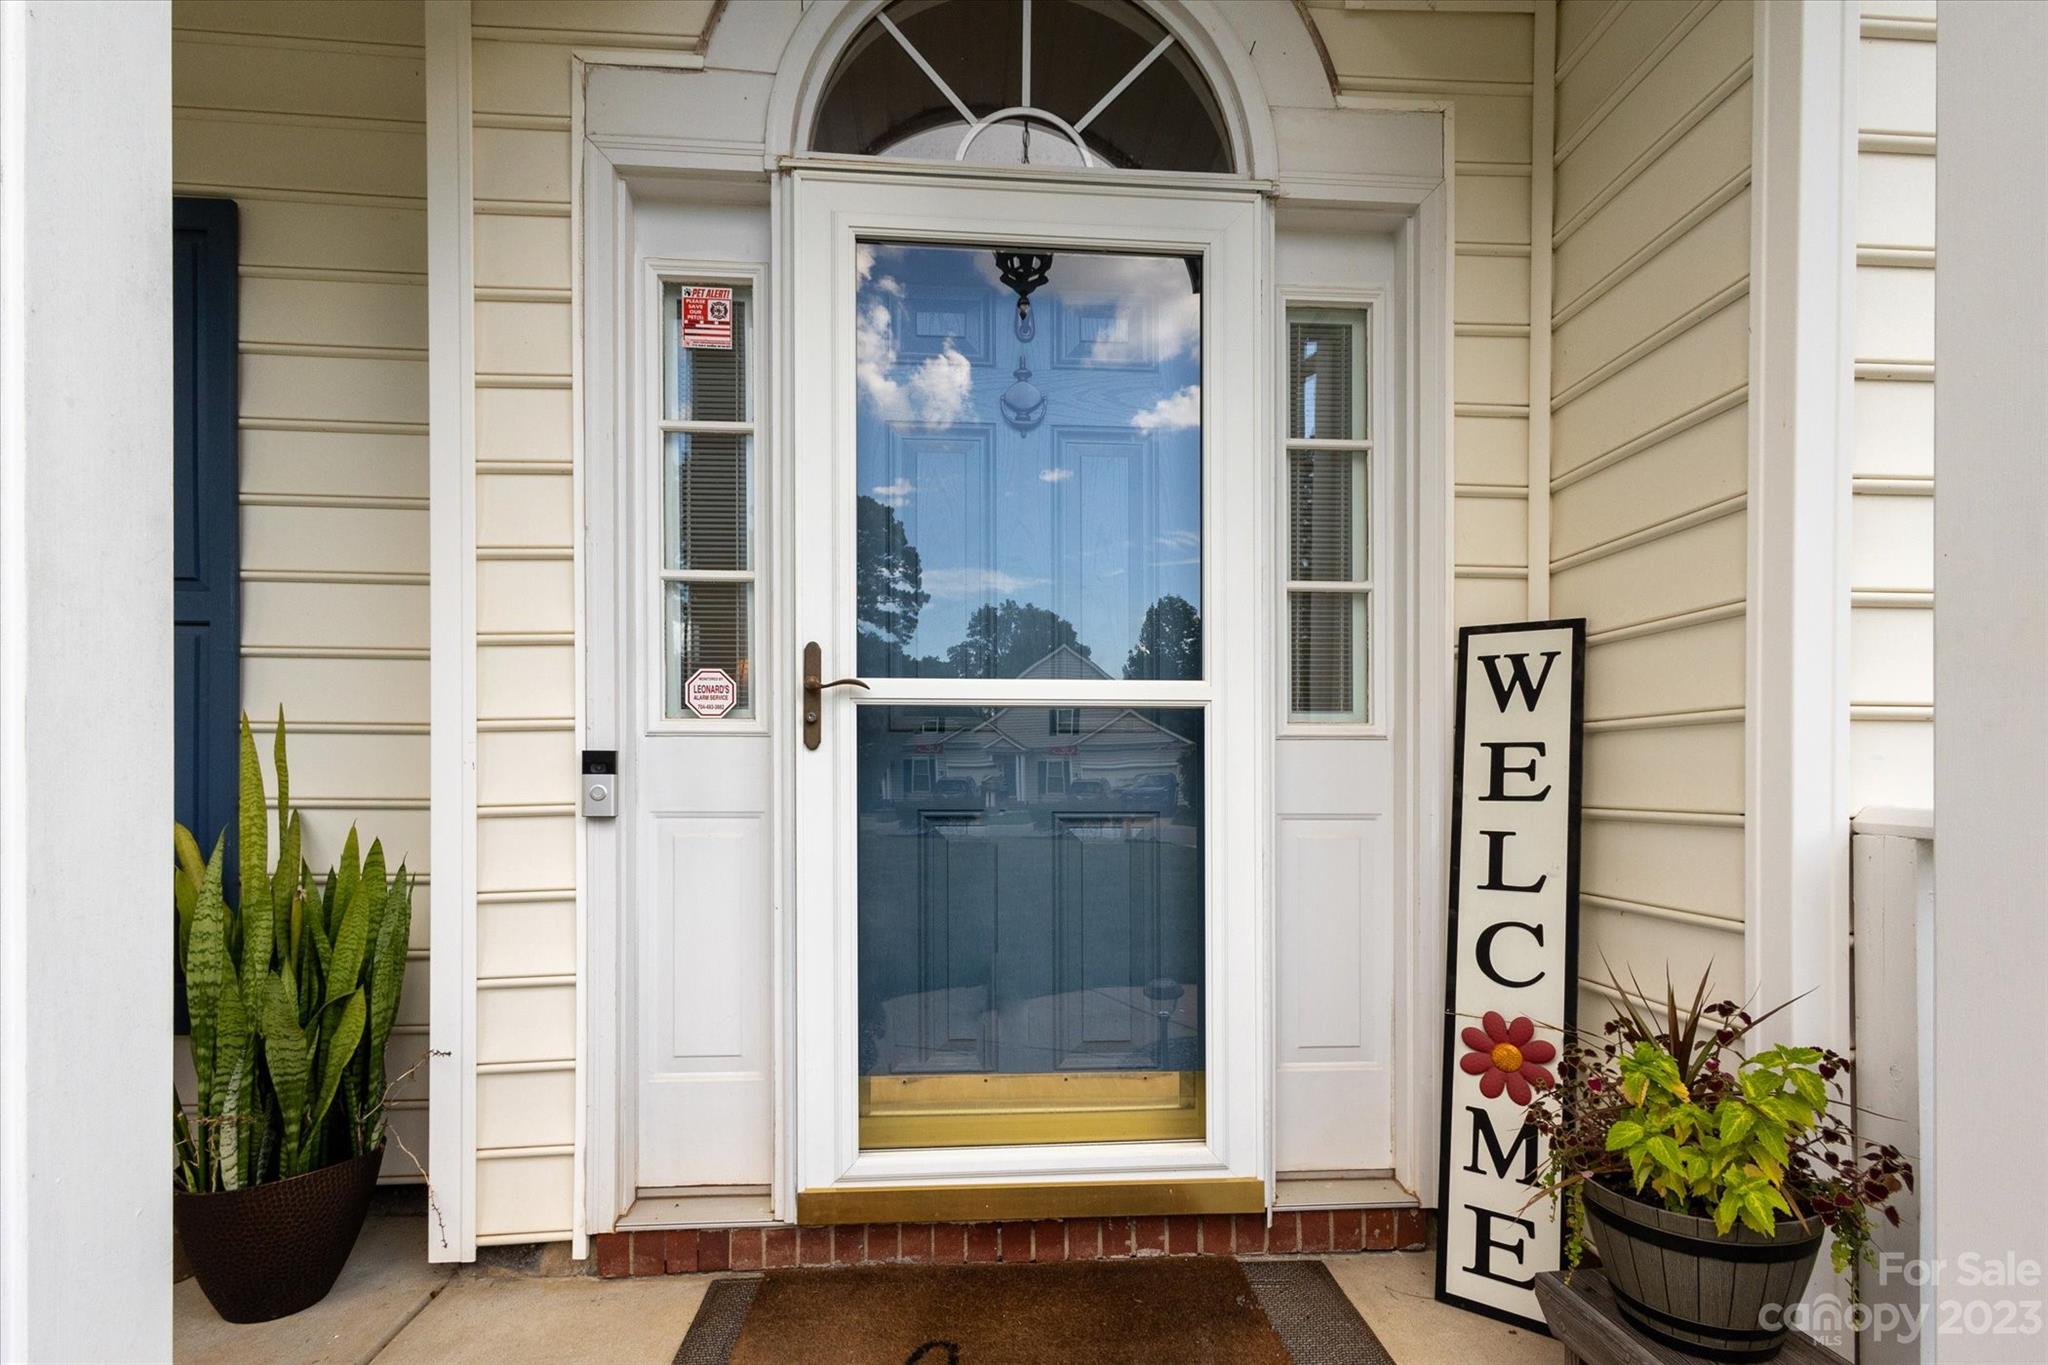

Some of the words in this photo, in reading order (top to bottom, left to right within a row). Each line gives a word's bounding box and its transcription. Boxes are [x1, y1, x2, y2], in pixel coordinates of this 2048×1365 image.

[692, 289, 706, 297] PET
[706, 289, 730, 298] ALERT!
[693, 685, 730, 694] LEONARD'S
